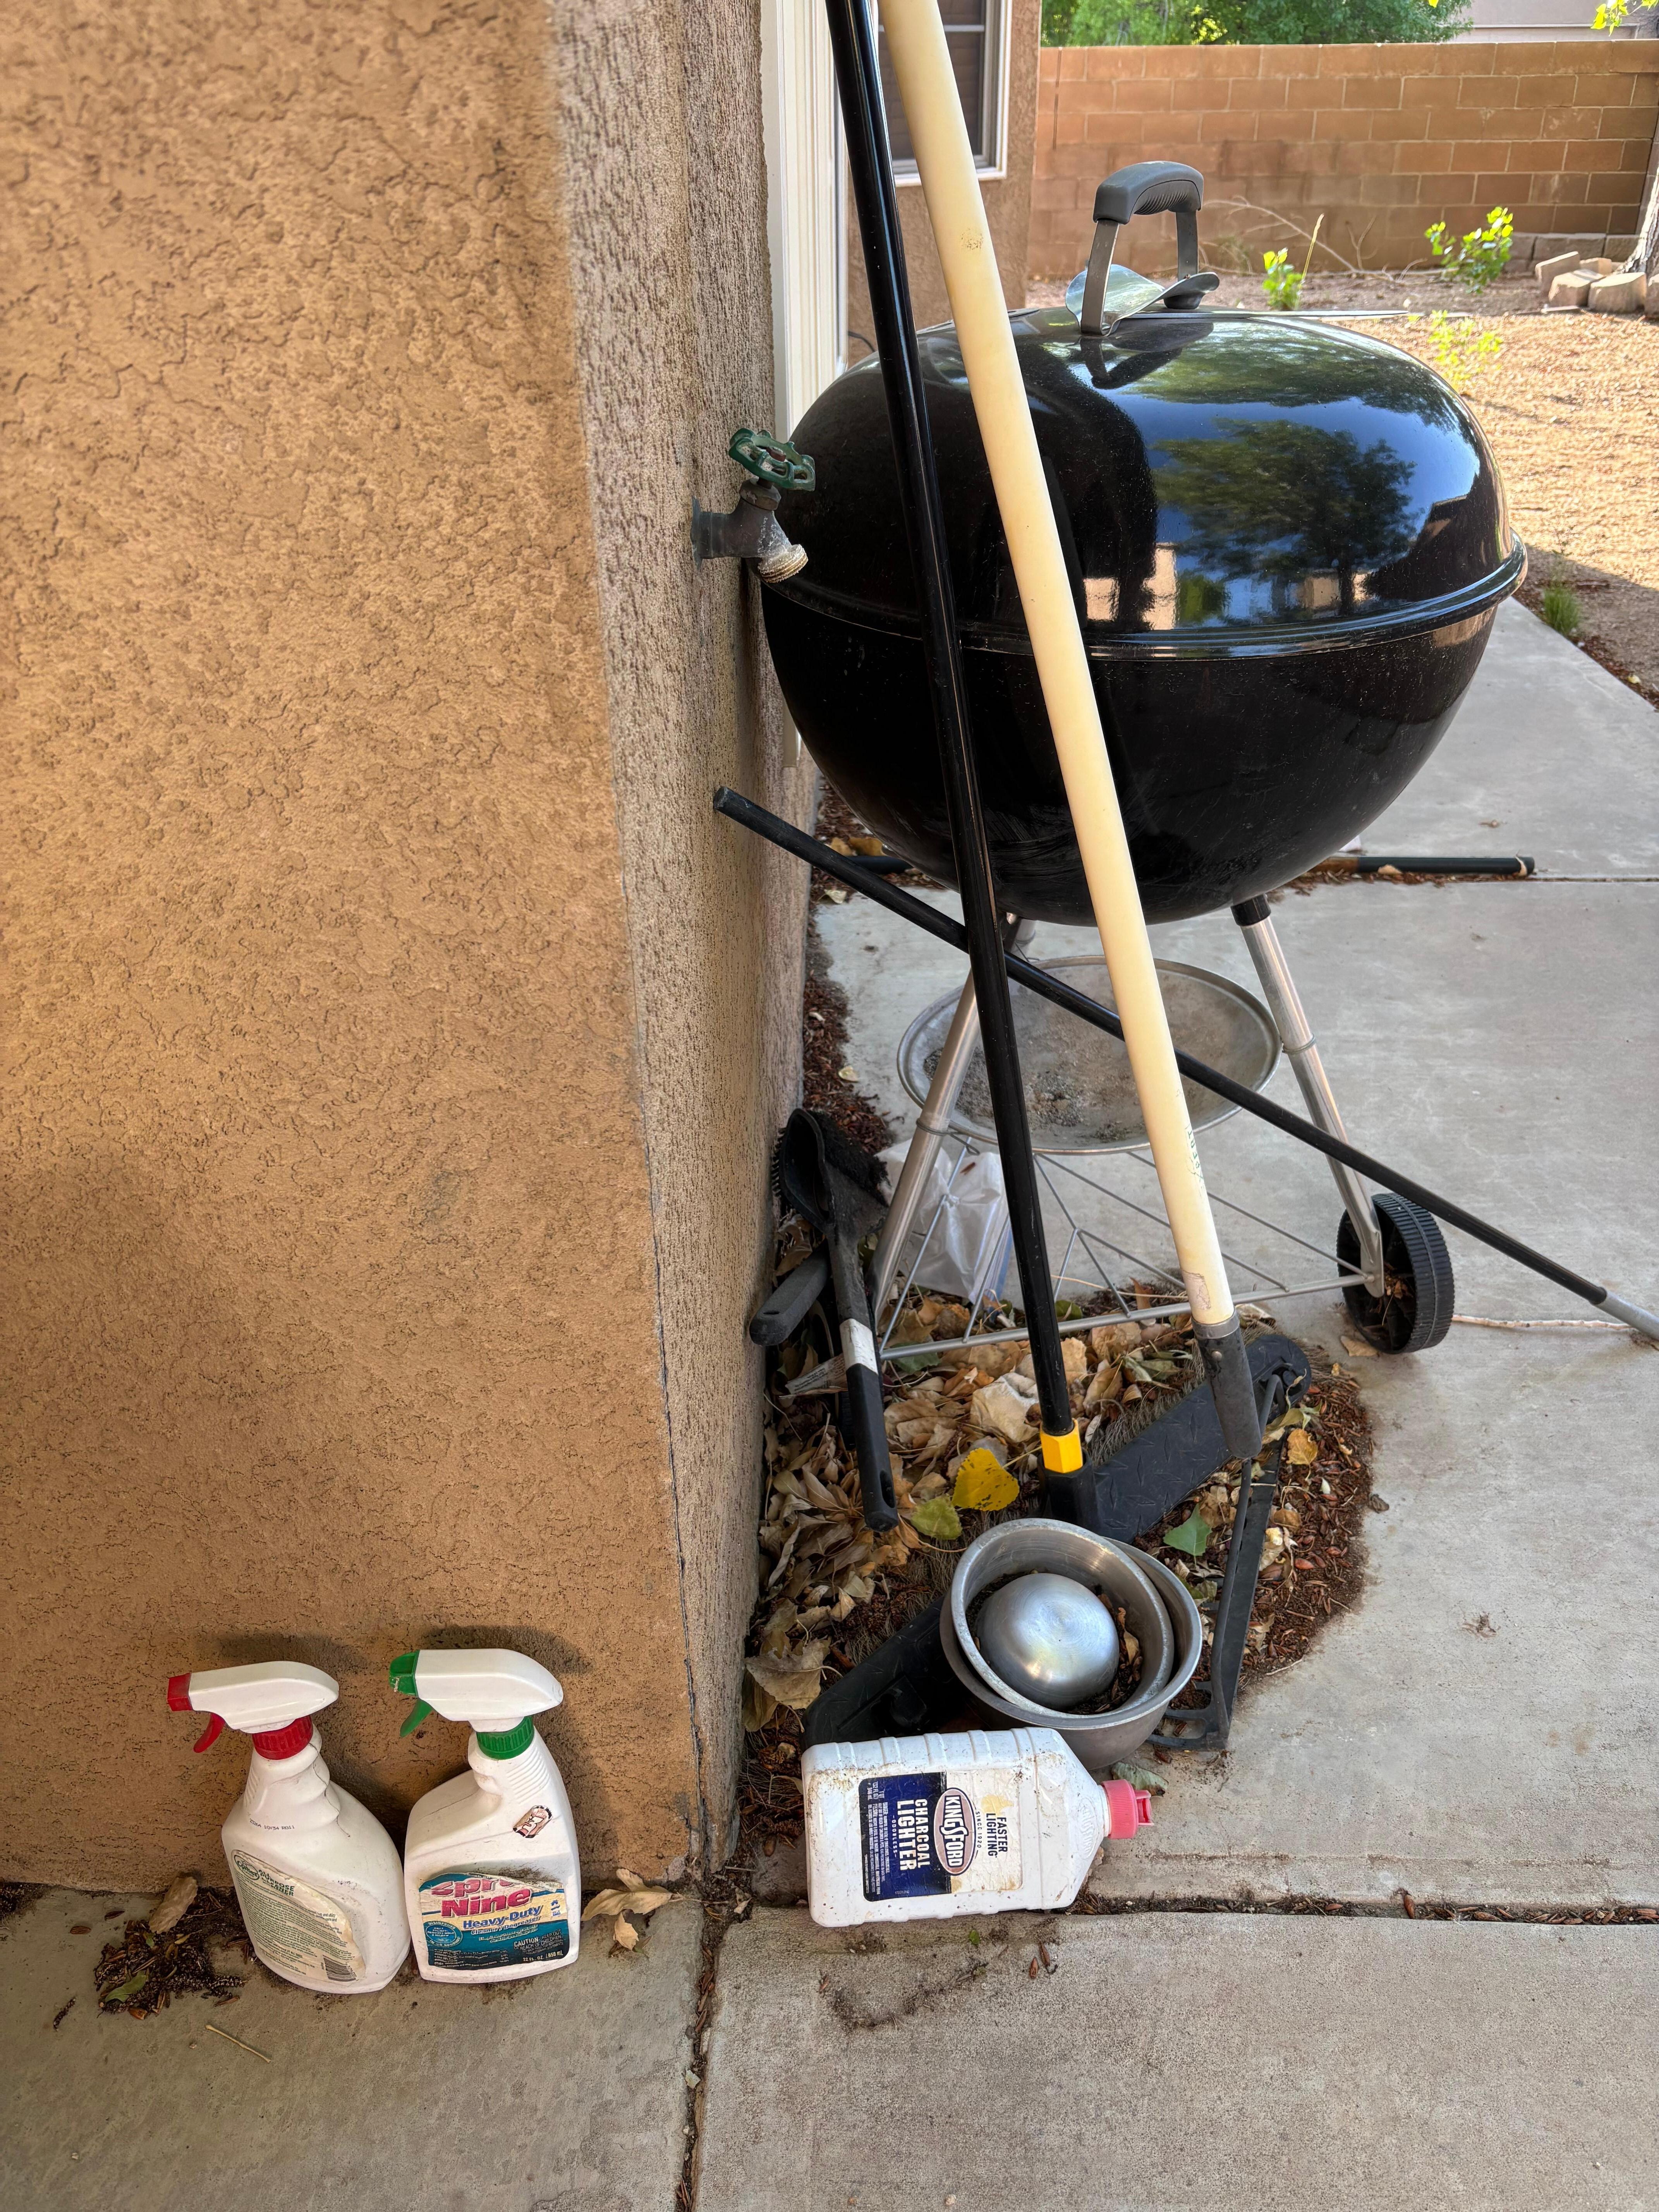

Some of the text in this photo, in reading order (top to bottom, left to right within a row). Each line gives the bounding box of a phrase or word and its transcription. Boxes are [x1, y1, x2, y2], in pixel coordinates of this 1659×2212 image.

[897, 1800, 917, 1870] LIGHTER
[915, 1799, 930, 1868] CHARCOAL
[941, 1796, 968, 1866] KINGSFORD
[997, 1817, 1008, 1852] FASTER
[441, 1889, 531, 1917] Nine
[463, 1905, 543, 1929] Heavy-Duty
[514, 1936, 540, 1947] CAUTION:
[541, 1935, 563, 1946] CHILDREN.
